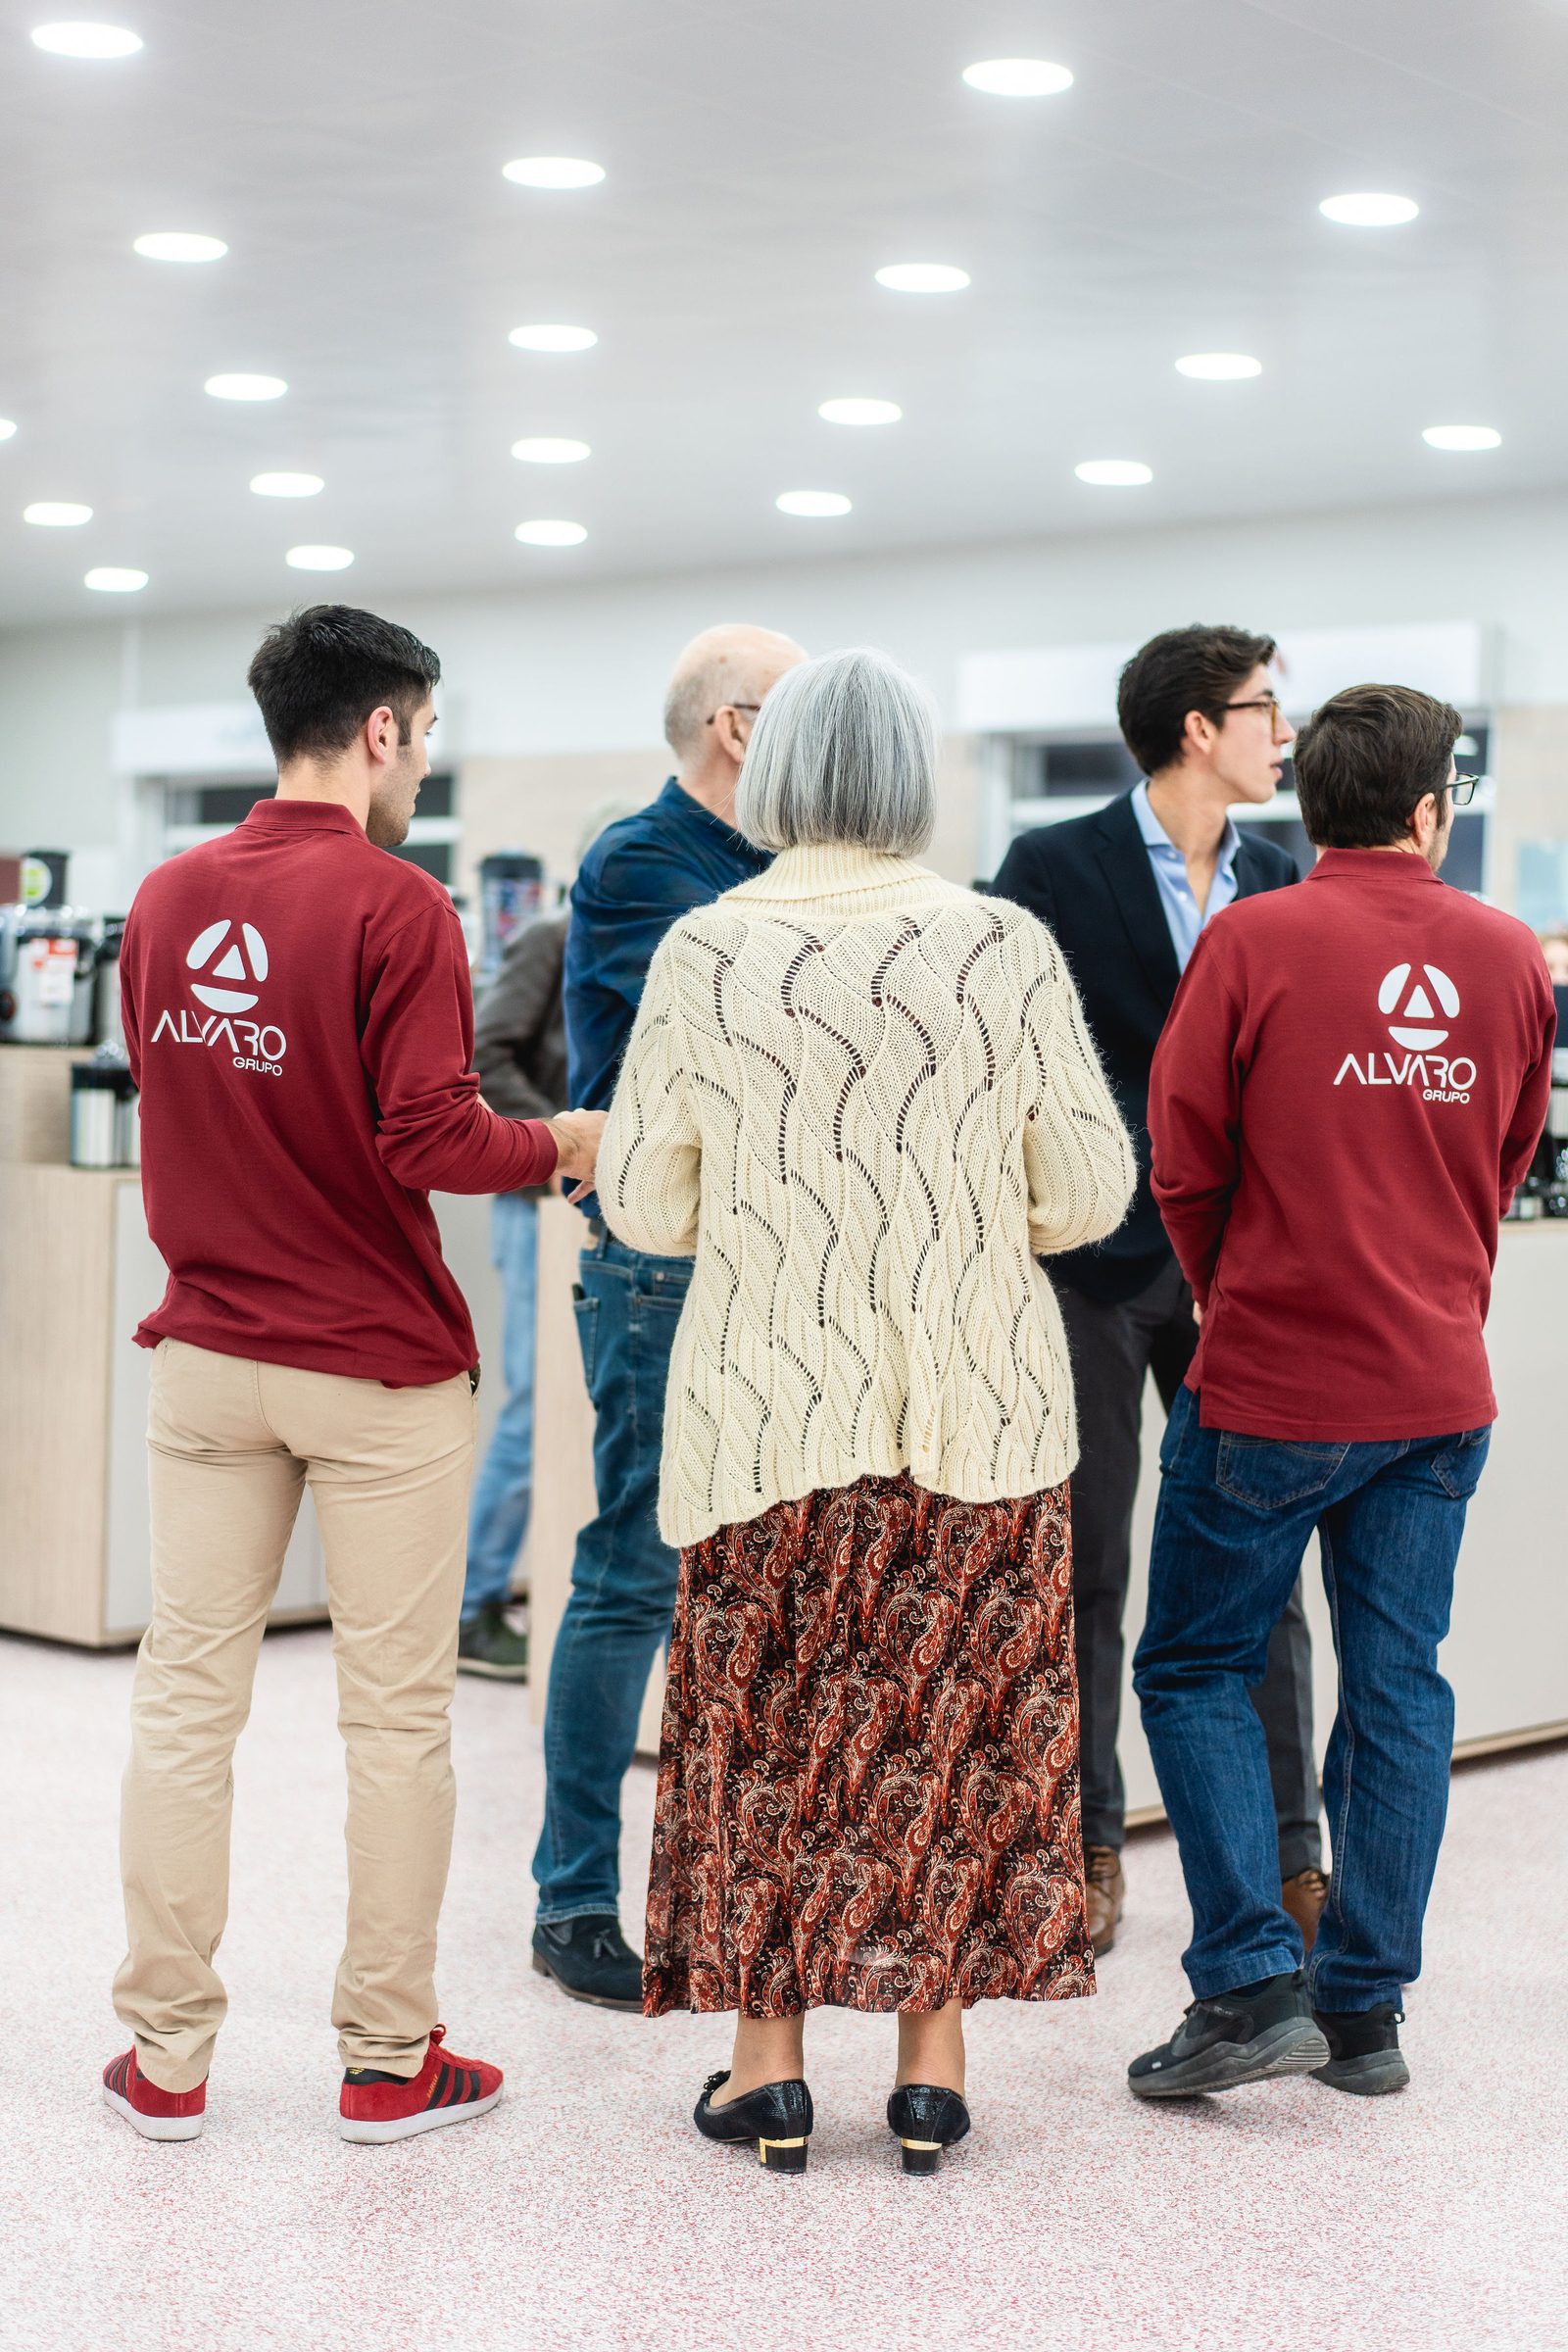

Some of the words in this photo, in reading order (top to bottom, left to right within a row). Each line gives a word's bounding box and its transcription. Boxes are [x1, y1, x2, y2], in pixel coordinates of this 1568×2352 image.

[151, 1009, 287, 1061] ALVARO
[232, 1056, 283, 1077] GRUPO
[1333, 1053, 1477, 1091] ALVARO
[1422, 1089, 1471, 1104] GRUPO
